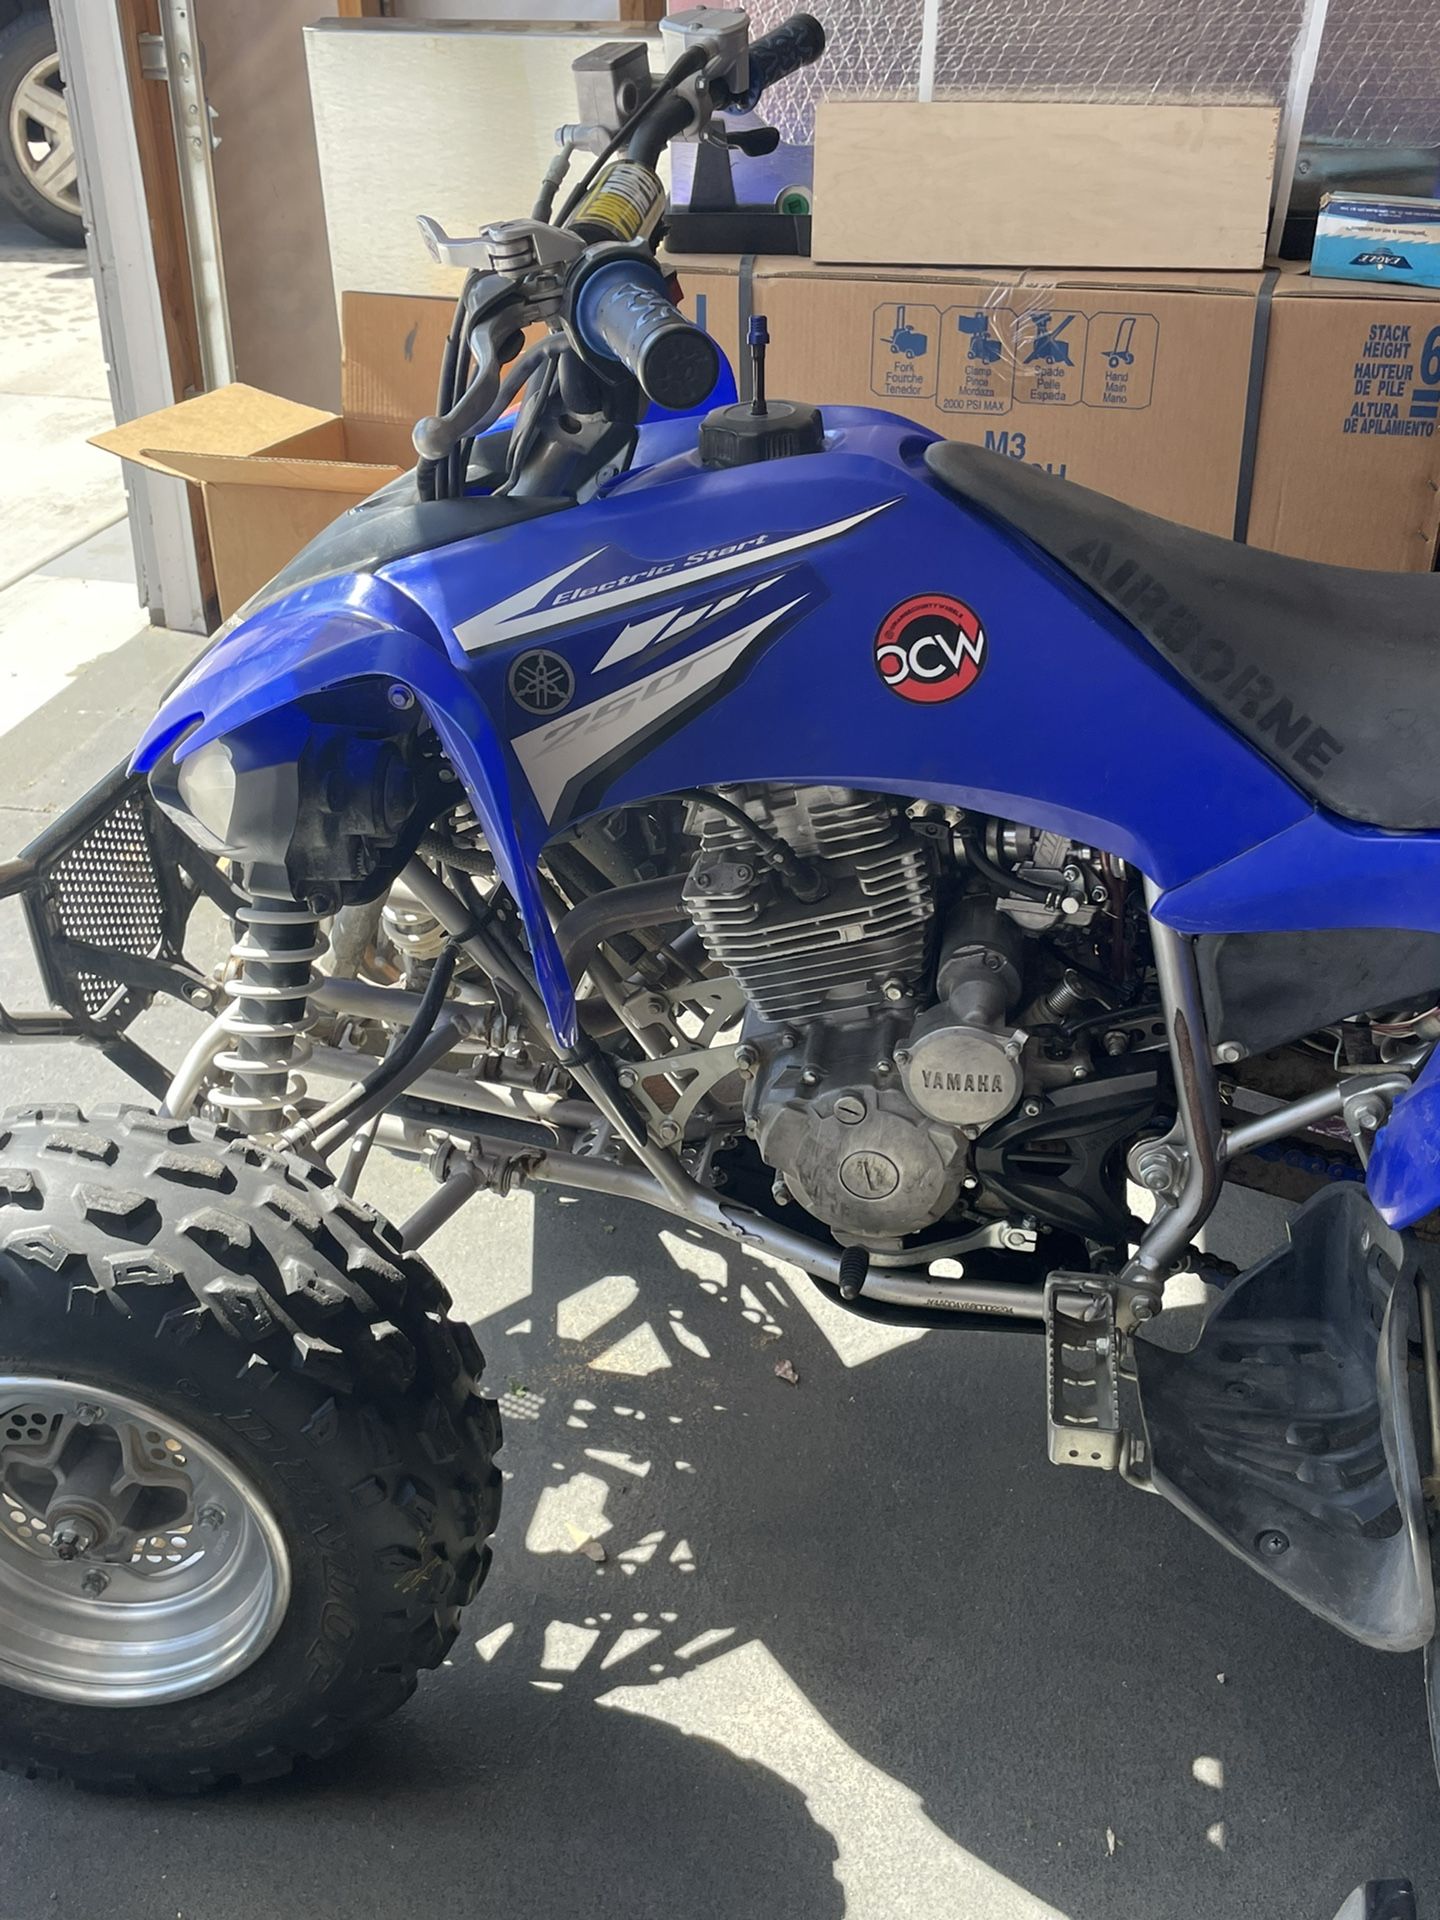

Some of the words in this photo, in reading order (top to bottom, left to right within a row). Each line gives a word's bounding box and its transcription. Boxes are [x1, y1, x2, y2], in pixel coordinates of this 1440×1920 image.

[1359, 254, 1402, 265] EAGLE
[1369, 324, 1411, 342] STACK
[1363, 342, 1411, 359] HEIGHT
[894, 362, 914, 373] Fork
[965, 366, 992, 378] Clamp
[1034, 366, 1065, 378] Spade
[1354, 363, 1413, 380] HAUTEUR
[886, 372, 923, 384] Fourche
[966, 376, 989, 387] Pince
[1105, 371, 1129, 382] Hand
[885, 383, 922, 395] Tenedor
[1037, 378, 1061, 390] Pelle
[1105, 382, 1127, 393] Main
[1355, 380, 1371, 395] DE
[1378, 381, 1405, 397] PILE
[959, 386, 994, 397] Mordaza
[1031, 389, 1066, 402] Espada
[1103, 393, 1128, 404] Mano
[943, 399, 965, 409] 2000
[968, 400, 982, 410] PSI
[984, 401, 1004, 411] MAX
[1350, 402, 1399, 418] ALTURA
[1343, 418, 1358, 433] DE
[1361, 419, 1434, 437] APILAMIENTO
[985, 430, 1026, 461] M3
[552, 564, 675, 606] Electric
[684, 535, 769, 567] Start
[877, 629, 985, 685] OCW
[1065, 540, 1344, 781] AIRBORNE
[532, 636, 735, 760] 250
[922, 1069, 1003, 1092] YAMAHA
